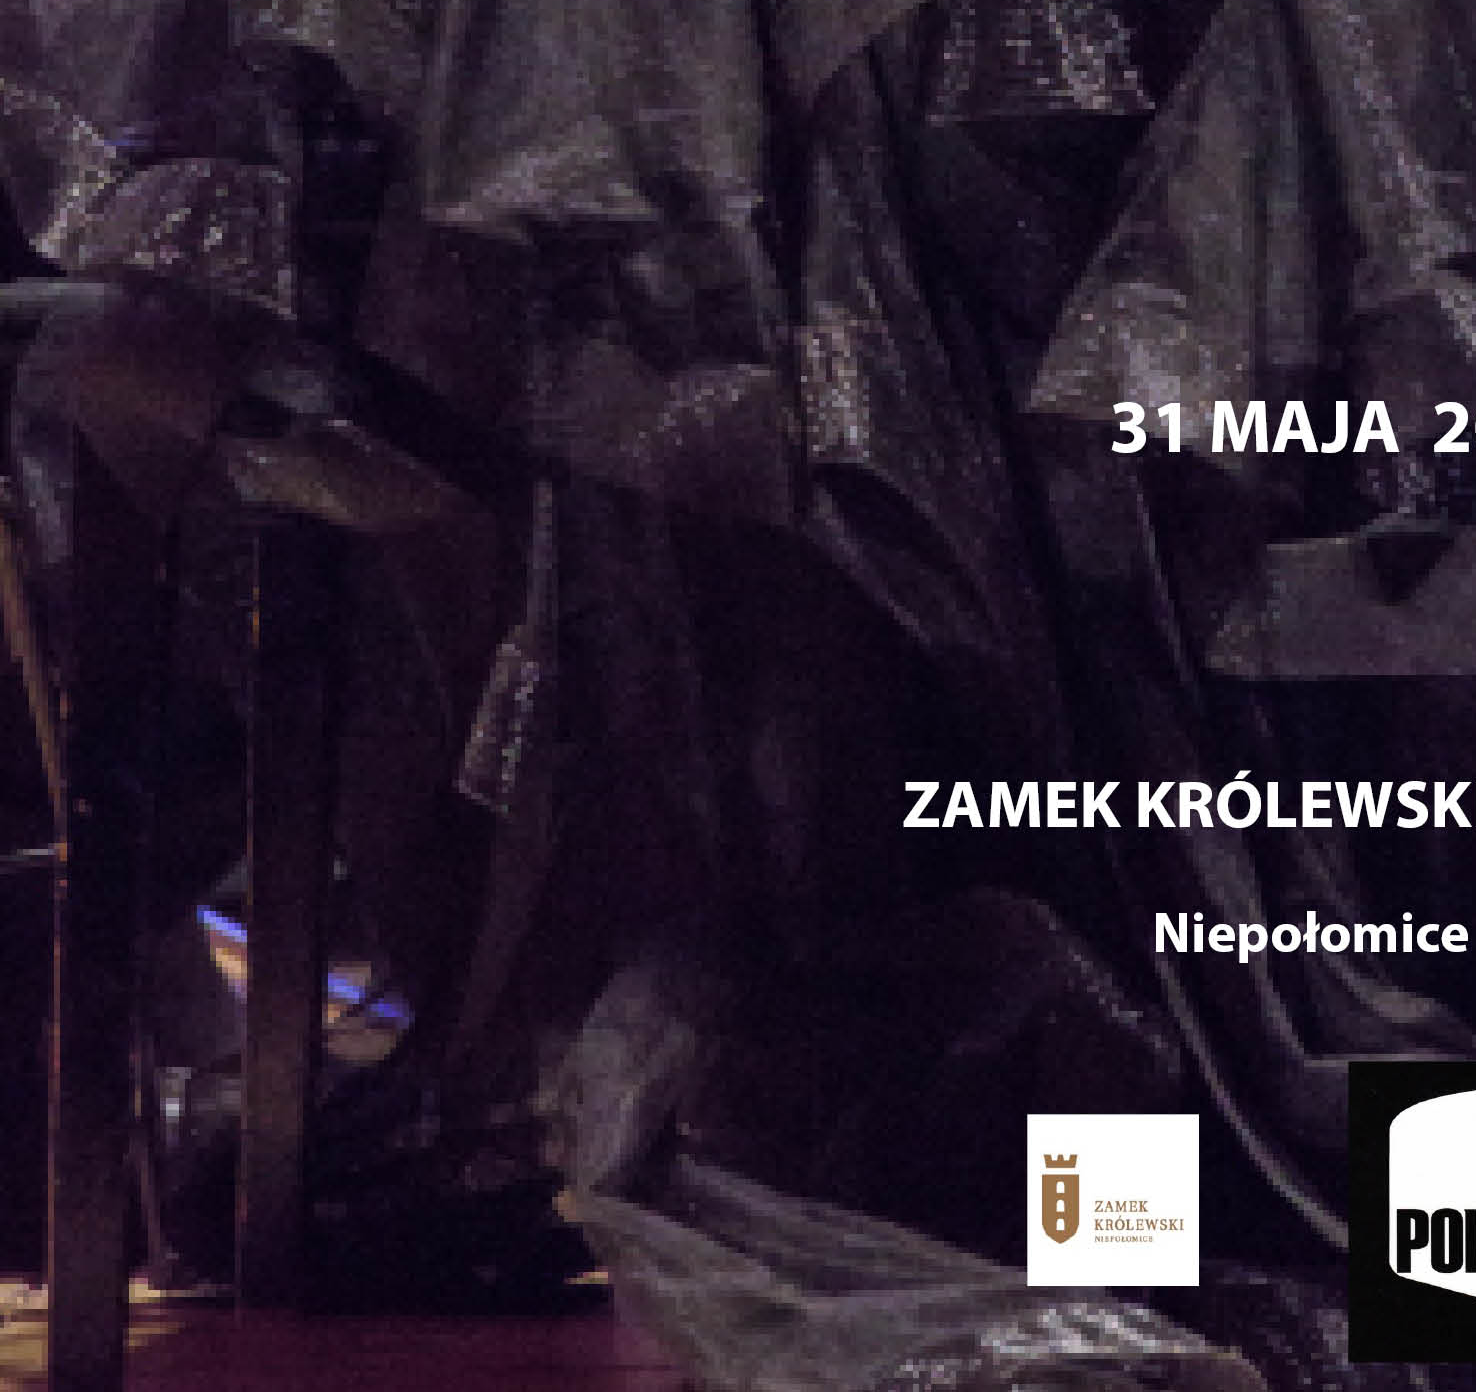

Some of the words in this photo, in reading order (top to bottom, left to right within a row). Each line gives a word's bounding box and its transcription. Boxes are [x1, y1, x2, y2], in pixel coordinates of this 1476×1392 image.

[1111, 401, 1181, 454] 31
[1212, 400, 1399, 454] MAJA
[903, 781, 1121, 828] ZAMEK
[1155, 910, 1469, 964] Niepołomice
[1094, 1200, 1148, 1213] ZAMEK
[1094, 1215, 1185, 1231] KRÓLEWSKI
